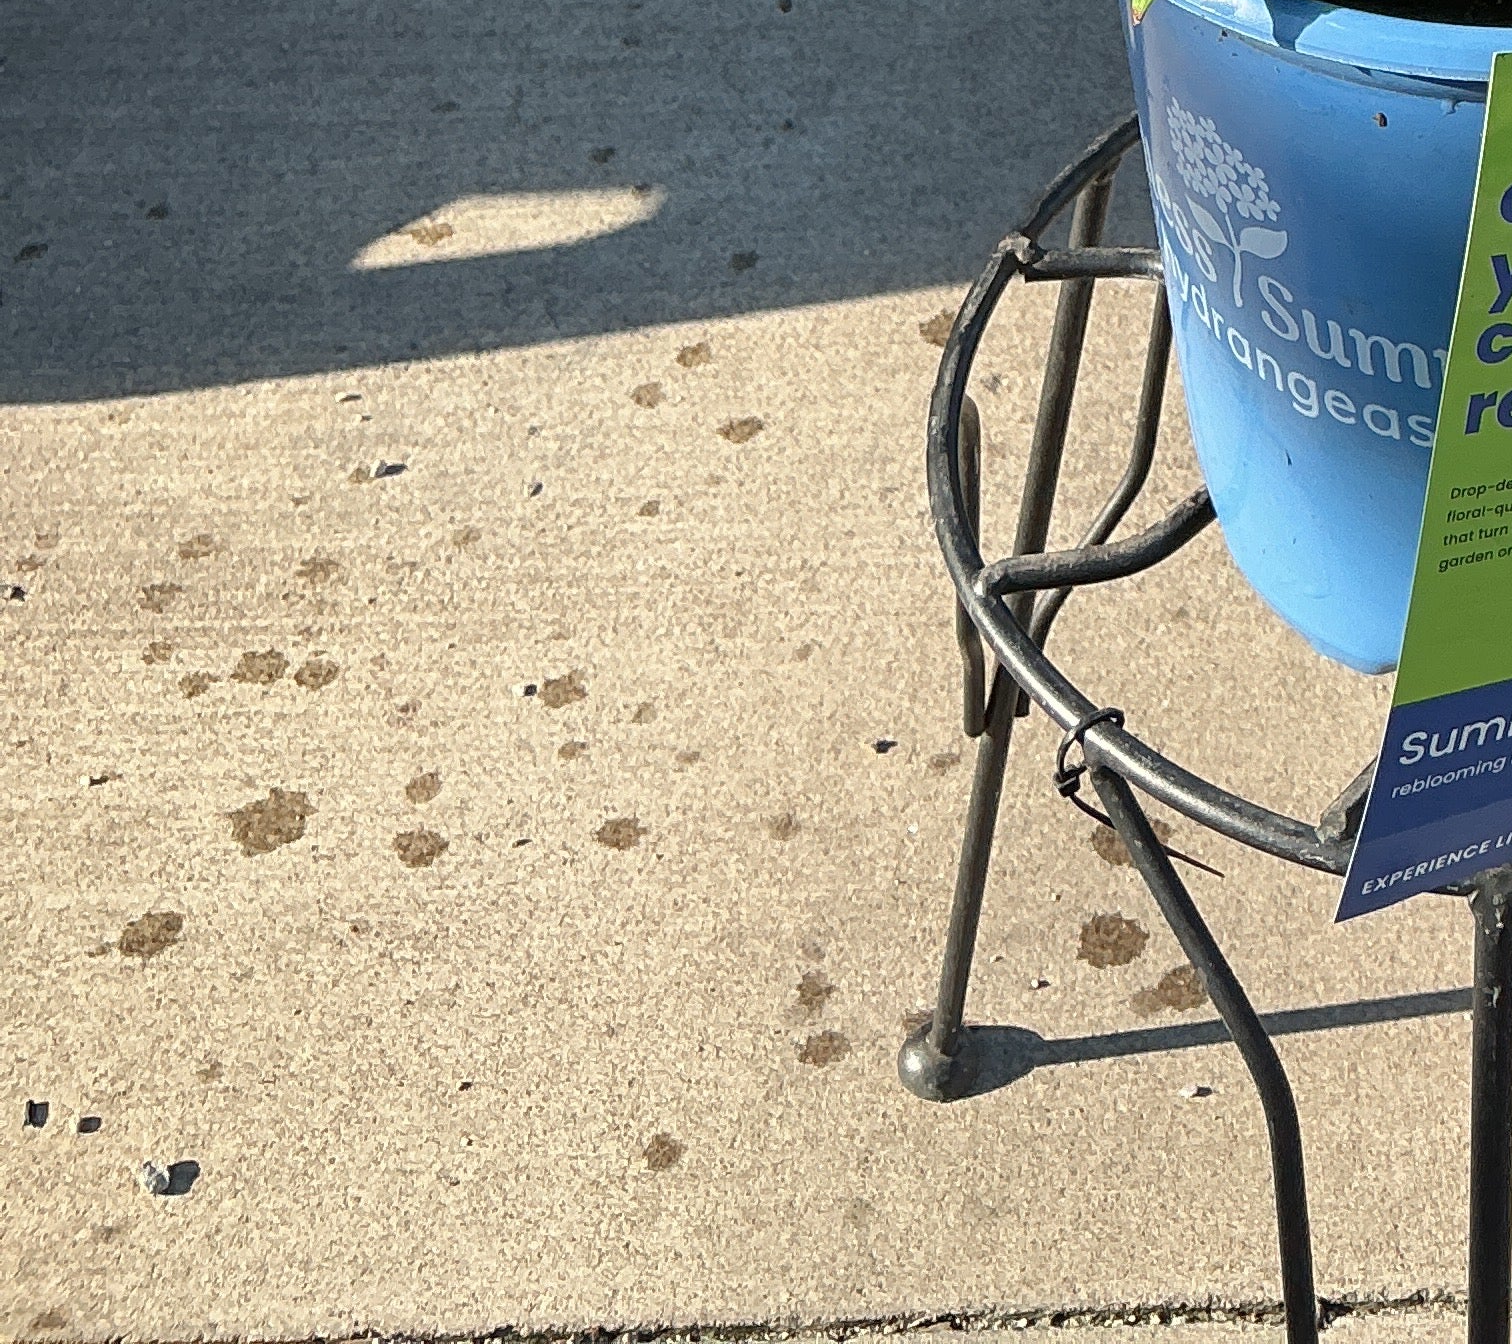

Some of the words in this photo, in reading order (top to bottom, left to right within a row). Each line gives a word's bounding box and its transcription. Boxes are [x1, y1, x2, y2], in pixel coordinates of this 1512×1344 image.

[1443, 530, 1474, 547] that
[1478, 524, 1508, 540] turn
[1438, 550, 1494, 573] garden
[1391, 755, 1507, 799] reblooming
[1361, 839, 1492, 896] EXPERIENCE
